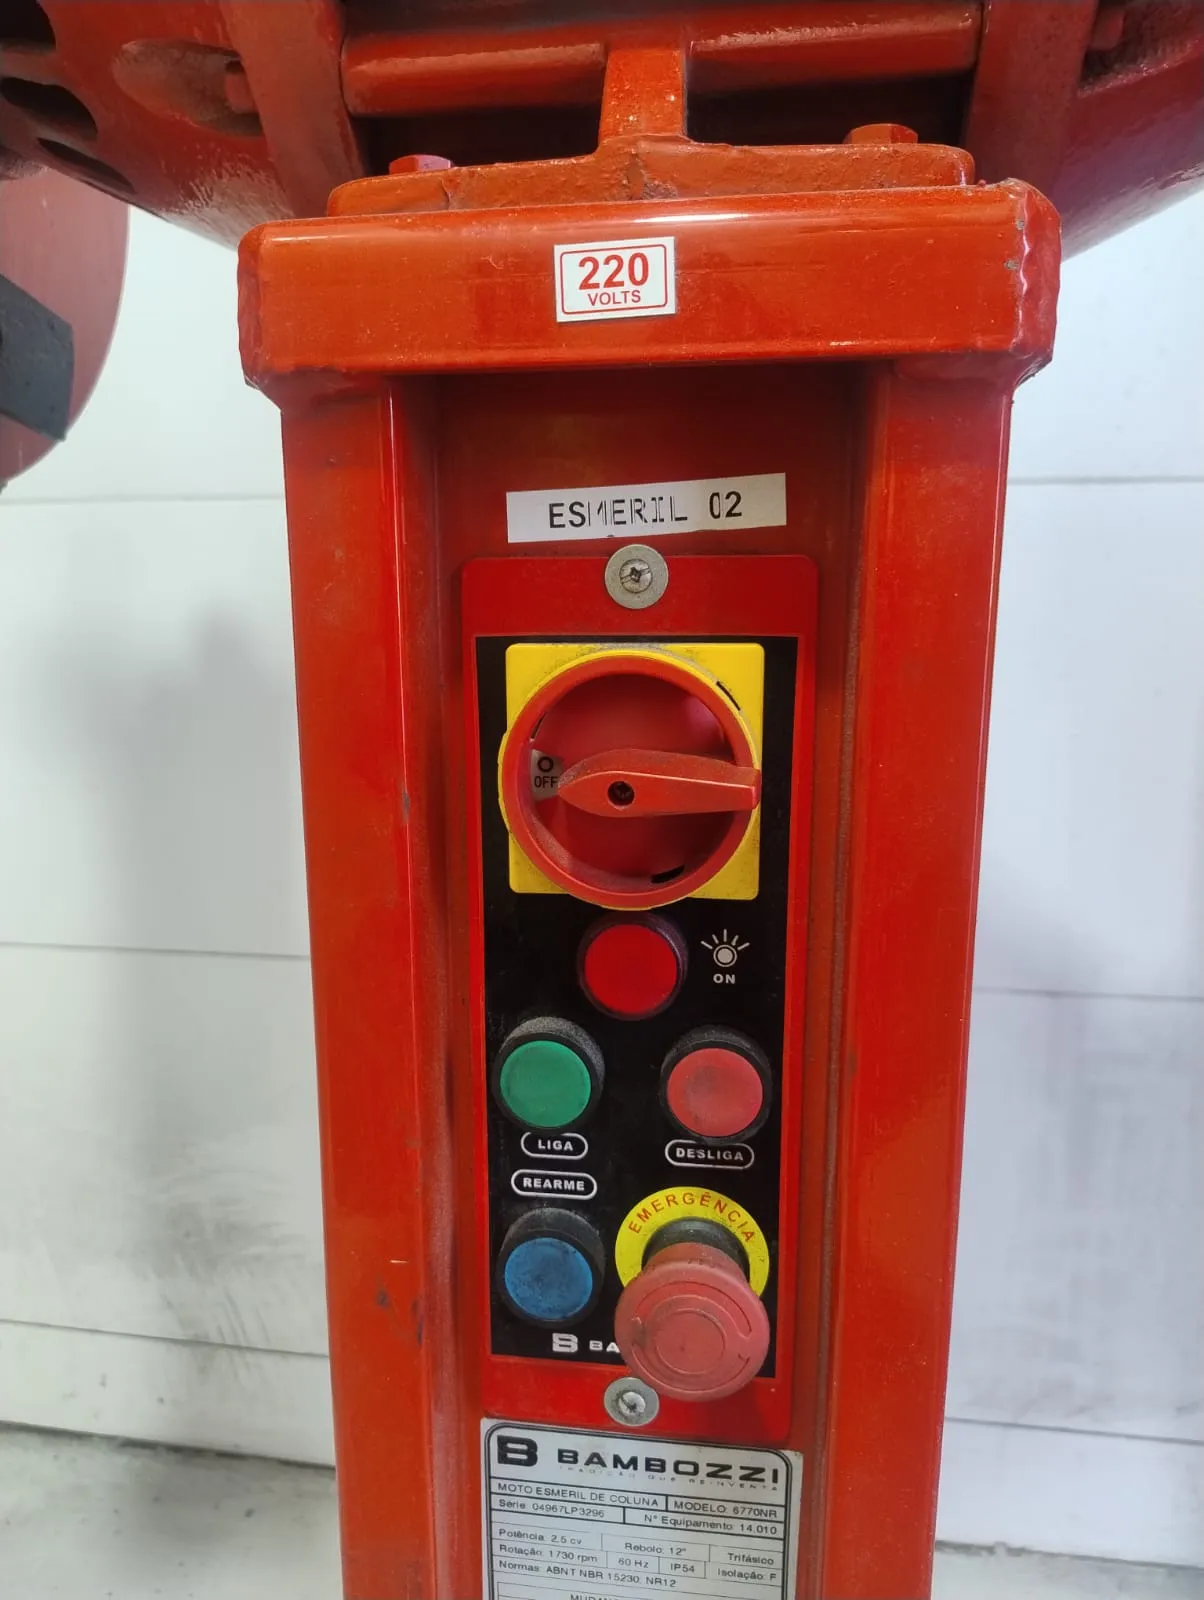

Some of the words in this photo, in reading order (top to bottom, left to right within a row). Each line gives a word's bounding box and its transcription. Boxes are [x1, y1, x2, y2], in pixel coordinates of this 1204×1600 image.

[578, 252, 649, 290] 220
[588, 289, 641, 306] VOLTS
[709, 490, 743, 519] 02
[534, 775, 560, 788] OFF
[713, 973, 736, 984] ON
[537, 1139, 574, 1152] LIGA
[675, 1147, 745, 1161] DESLIGA
[522, 1177, 586, 1192] REARME
[628, 1191, 755, 1243] EMERGÊNCIA
[557, 1448, 779, 1484] BAMBOZZI
[498, 1482, 533, 1494] MOTO
[535, 1486, 587, 1501] ESMERIL
[590, 1492, 605, 1502] DE
[609, 1494, 659, 1507] COLUNA
[732, 1505, 778, 1519] 6770NR
[549, 1550, 575, 1560] 1730
[577, 1554, 598, 1563] rpm
[634, 1560, 649, 1569] Hz
[670, 1563, 695, 1573] IP54
[546, 1566, 576, 1577] ABNT
[579, 1570, 604, 1580] NBR
[645, 1576, 677, 1588] NR12
[769, 1573, 777, 1581] F
